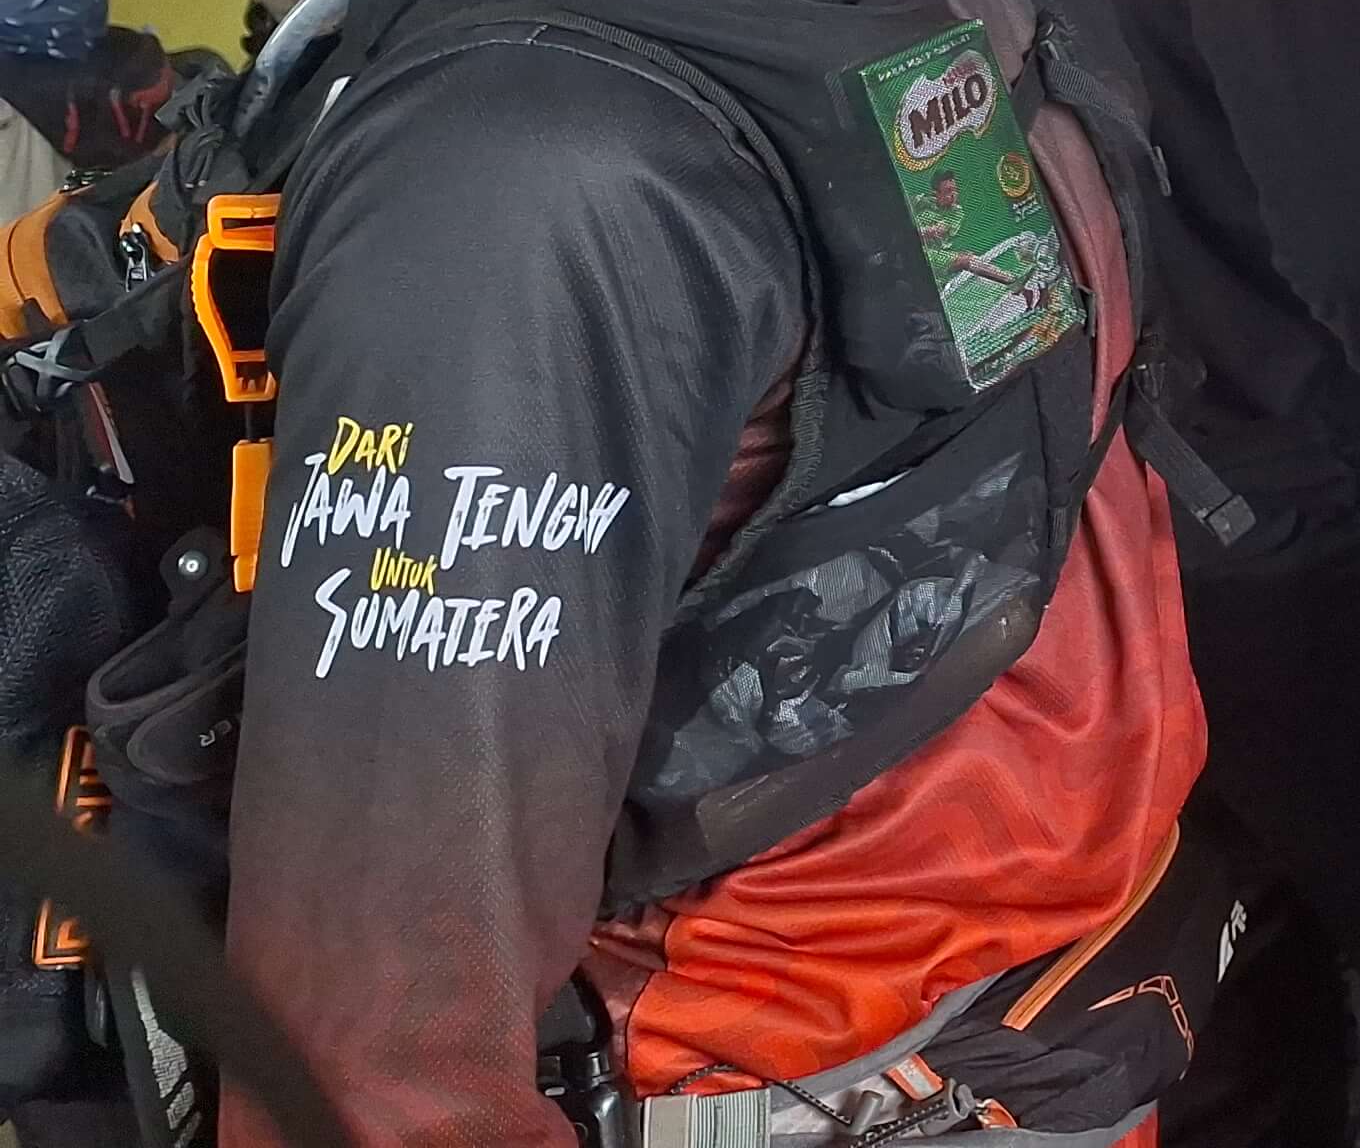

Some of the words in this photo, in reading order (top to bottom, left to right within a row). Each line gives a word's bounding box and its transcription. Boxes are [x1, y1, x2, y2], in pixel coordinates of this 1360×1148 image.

[908, 74, 989, 149] MILO
[328, 417, 414, 475] DARI
[281, 453, 411, 568] JAWA
[371, 547, 440, 595] UNTUK
[315, 568, 563, 678] SUMATERA
